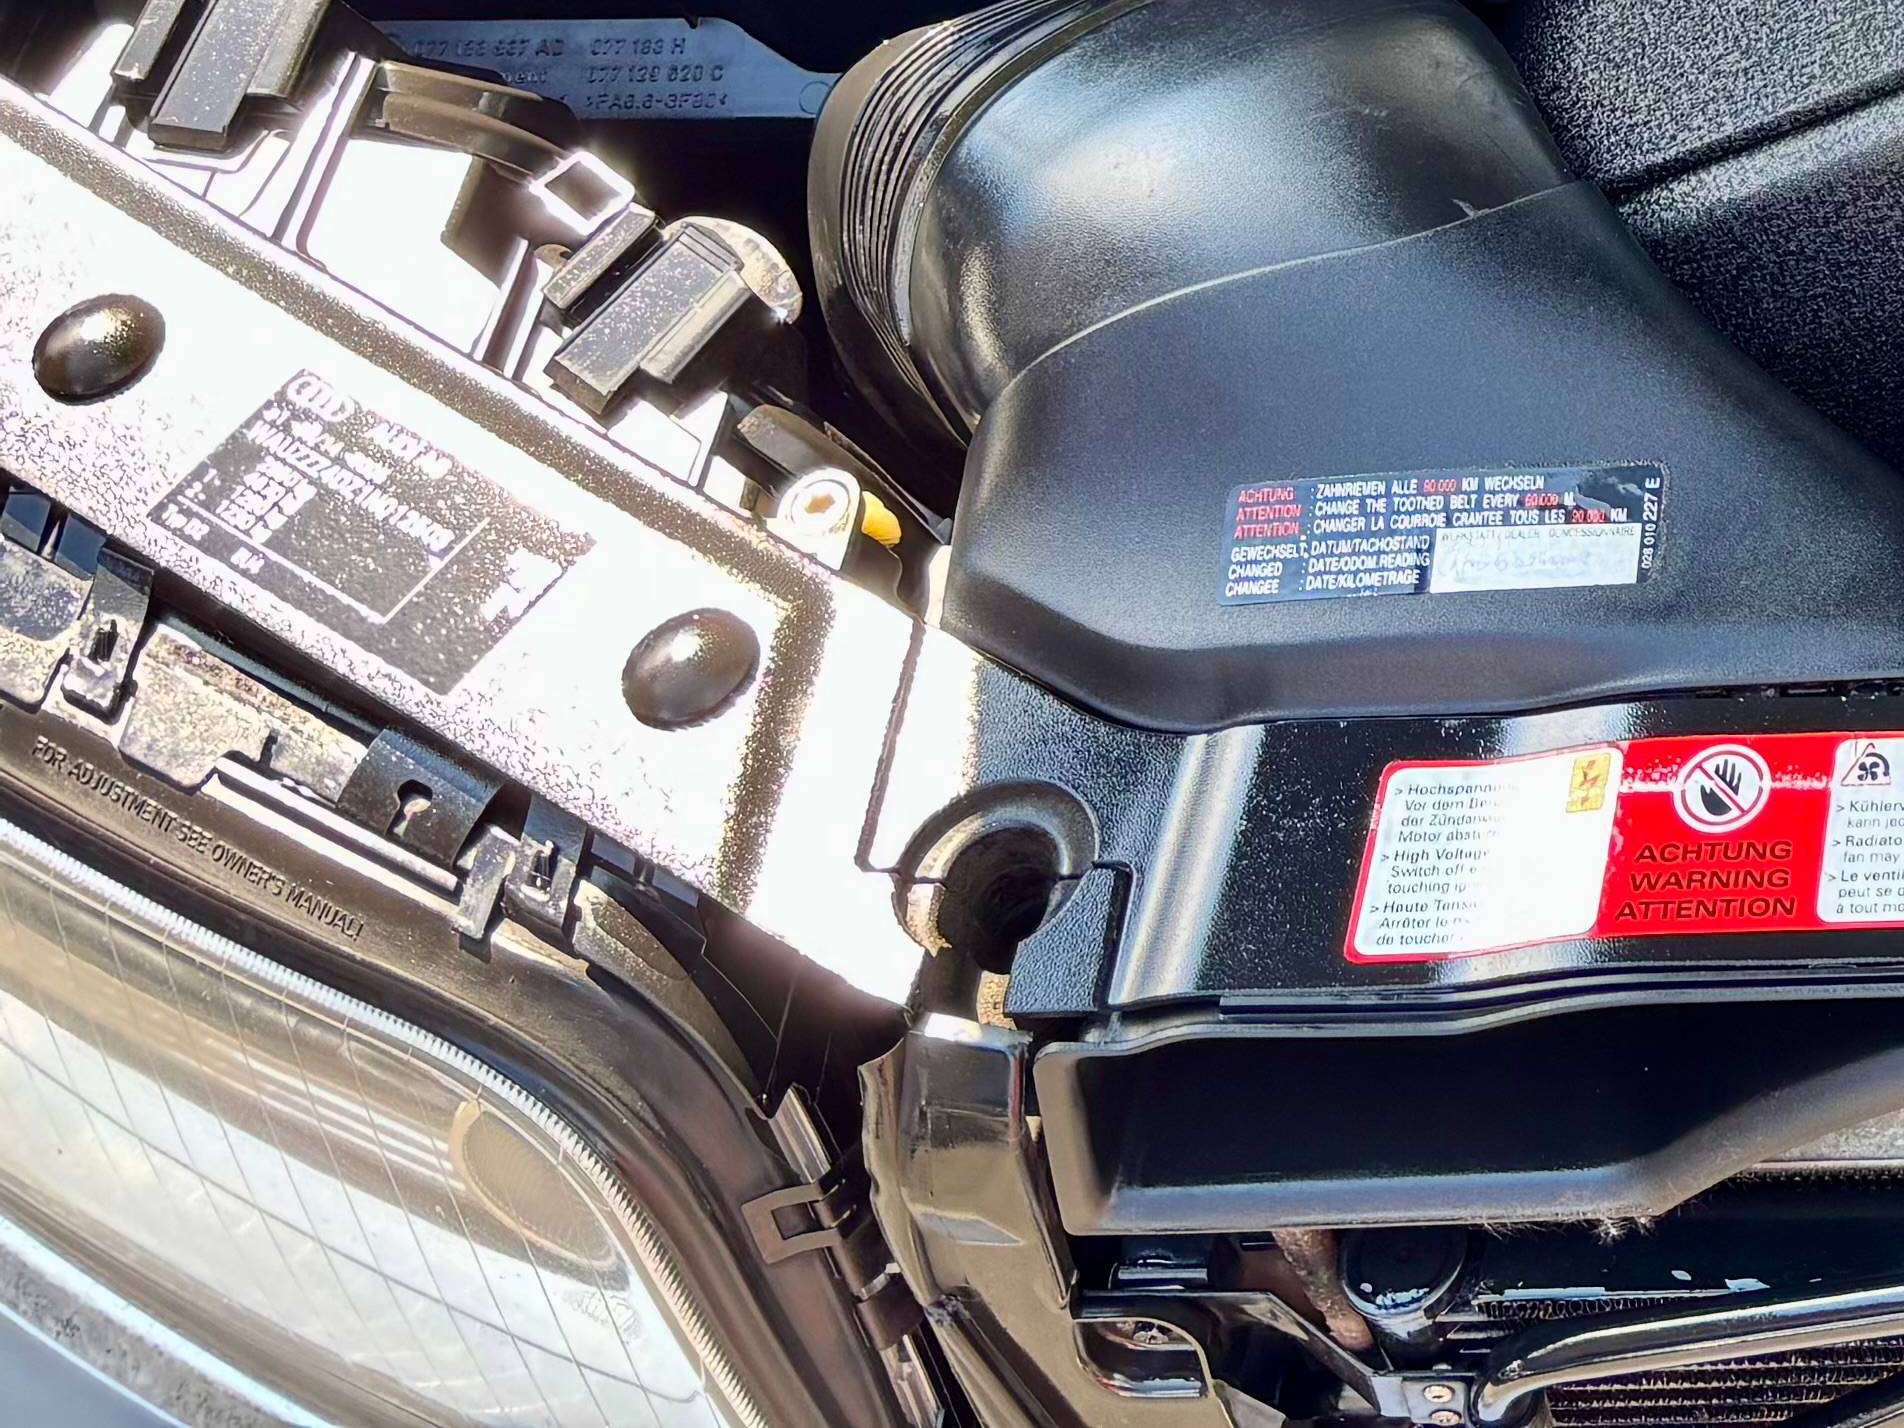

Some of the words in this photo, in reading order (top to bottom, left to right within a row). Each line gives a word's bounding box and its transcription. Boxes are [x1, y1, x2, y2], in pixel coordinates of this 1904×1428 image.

[671, 37, 686, 55] H
[1238, 487, 1295, 504] ACHTUNG
[1315, 480, 1387, 499] ZAHNRIEMEN
[1391, 479, 1419, 494] ALLE
[1461, 477, 1480, 492] KM
[1484, 475, 1546, 492] WECHSELN
[1645, 477, 1660, 489] E
[1235, 504, 1303, 522] ATTENTION
[1314, 498, 1361, 517] CHANGE
[1366, 497, 1387, 514] THE
[1449, 494, 1478, 510] BELT
[1482, 493, 1521, 509] EVERY
[1643, 491, 1659, 522] 227
[1234, 522, 1300, 541] ATTENTION
[1312, 517, 1367, 535] CHANGER
[1370, 517, 1386, 531] LA
[1389, 513, 1447, 530] COURROIE
[1509, 509, 1541, 525] TOUS
[1544, 508, 1566, 523] LES
[1610, 507, 1629, 523] KM
[1642, 523, 1657, 546] 010
[1310, 534, 1431, 557] DATUM/TACHOSTAND
[1640, 547, 1655, 570] 028
[1227, 561, 1283, 580] CHANGED
[1305, 569, 1421, 592] DATE/KILOMETRAGE
[1405, 799, 1427, 812] Vor
[1431, 798, 1466, 811] dem
[31, 735, 68, 772] FOR
[67, 759, 178, 834] ADJUSTMENT
[175, 820, 214, 855] SEE
[210, 841, 287, 896] OWNER'S
[1400, 814, 1426, 828] der
[1846, 815, 1882, 829] kann
[1398, 829, 1443, 844] Motor
[1393, 849, 1431, 865] High
[1633, 840, 1794, 863] ACHTUNG
[1843, 849, 1866, 864] fan
[1869, 850, 1899, 866] may
[1390, 864, 1441, 880] Switch
[1628, 867, 1792, 892] WARNING
[1840, 868, 1859, 883] Le
[1386, 880, 1451, 896] touching
[1837, 886, 1871, 900] peut
[1875, 886, 1893, 898] se
[1382, 899, 1430, 915] Haute
[1612, 895, 1799, 923] ATTENTION
[1849, 900, 1878, 914] tout
[1375, 934, 1395, 947] de
